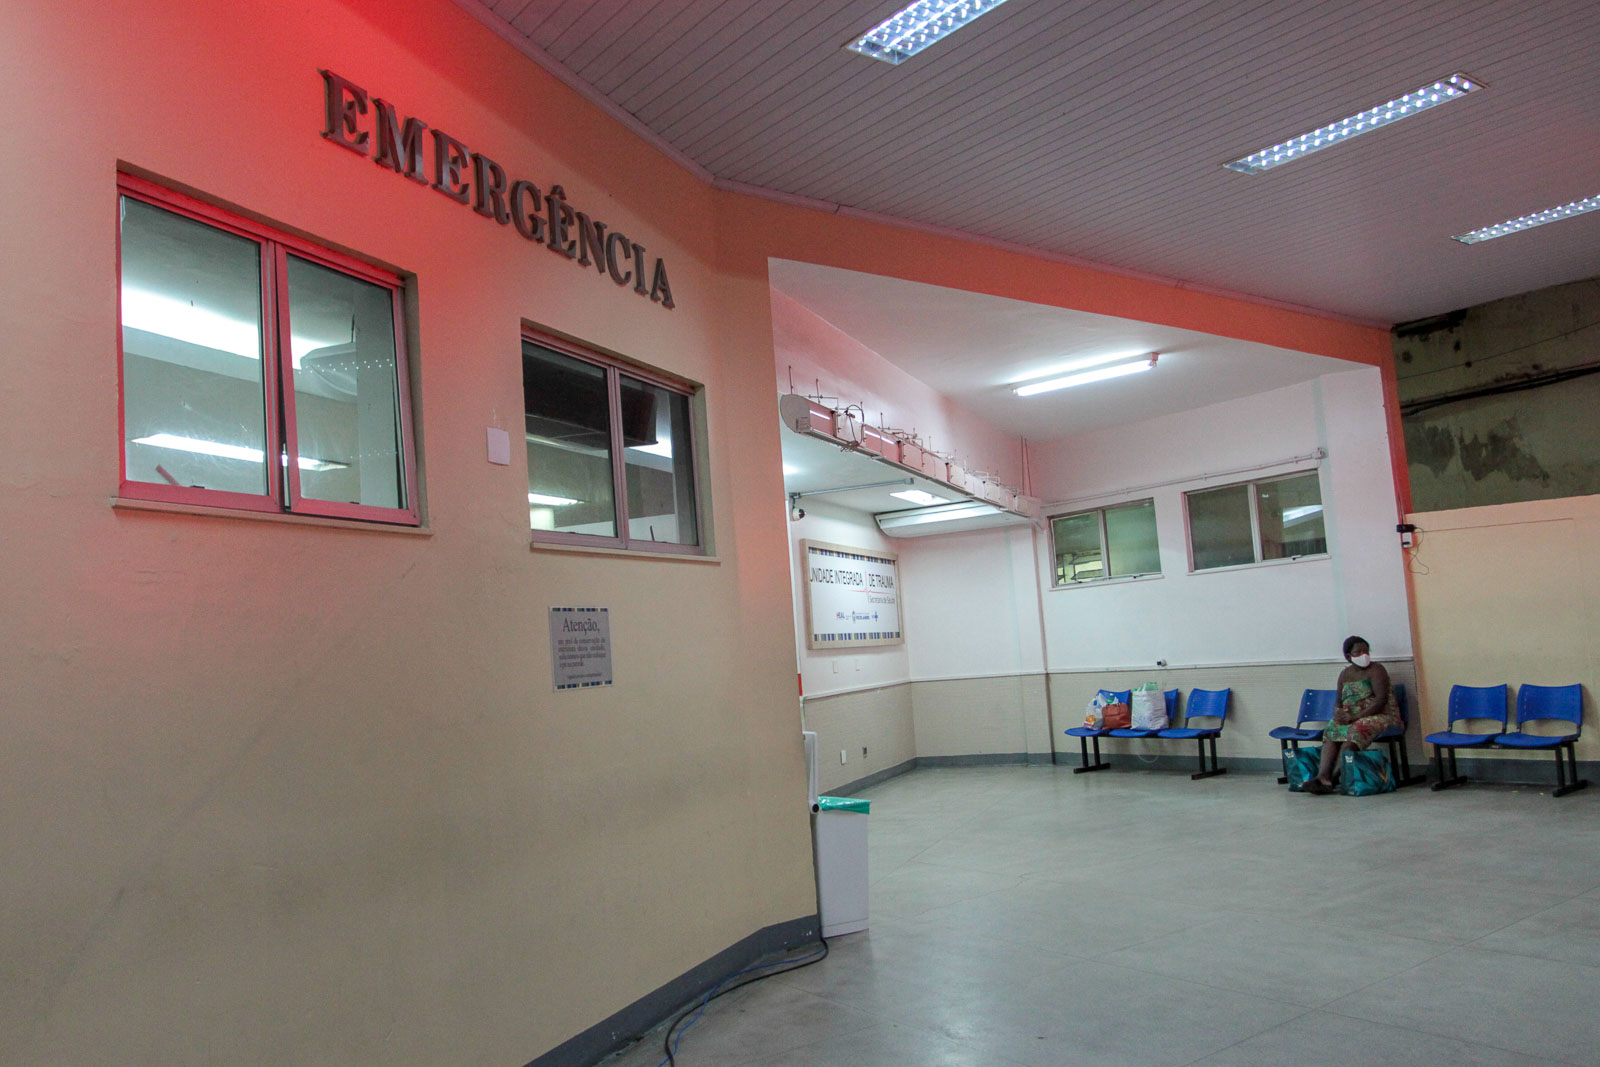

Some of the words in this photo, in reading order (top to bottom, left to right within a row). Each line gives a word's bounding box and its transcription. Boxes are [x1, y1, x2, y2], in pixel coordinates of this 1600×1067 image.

[317, 68, 675, 310] EMERGÊNCIA
[834, 570, 864, 586] INTEGRADA
[868, 573, 875, 587] DE
[875, 574, 894, 589] TRAUMA
